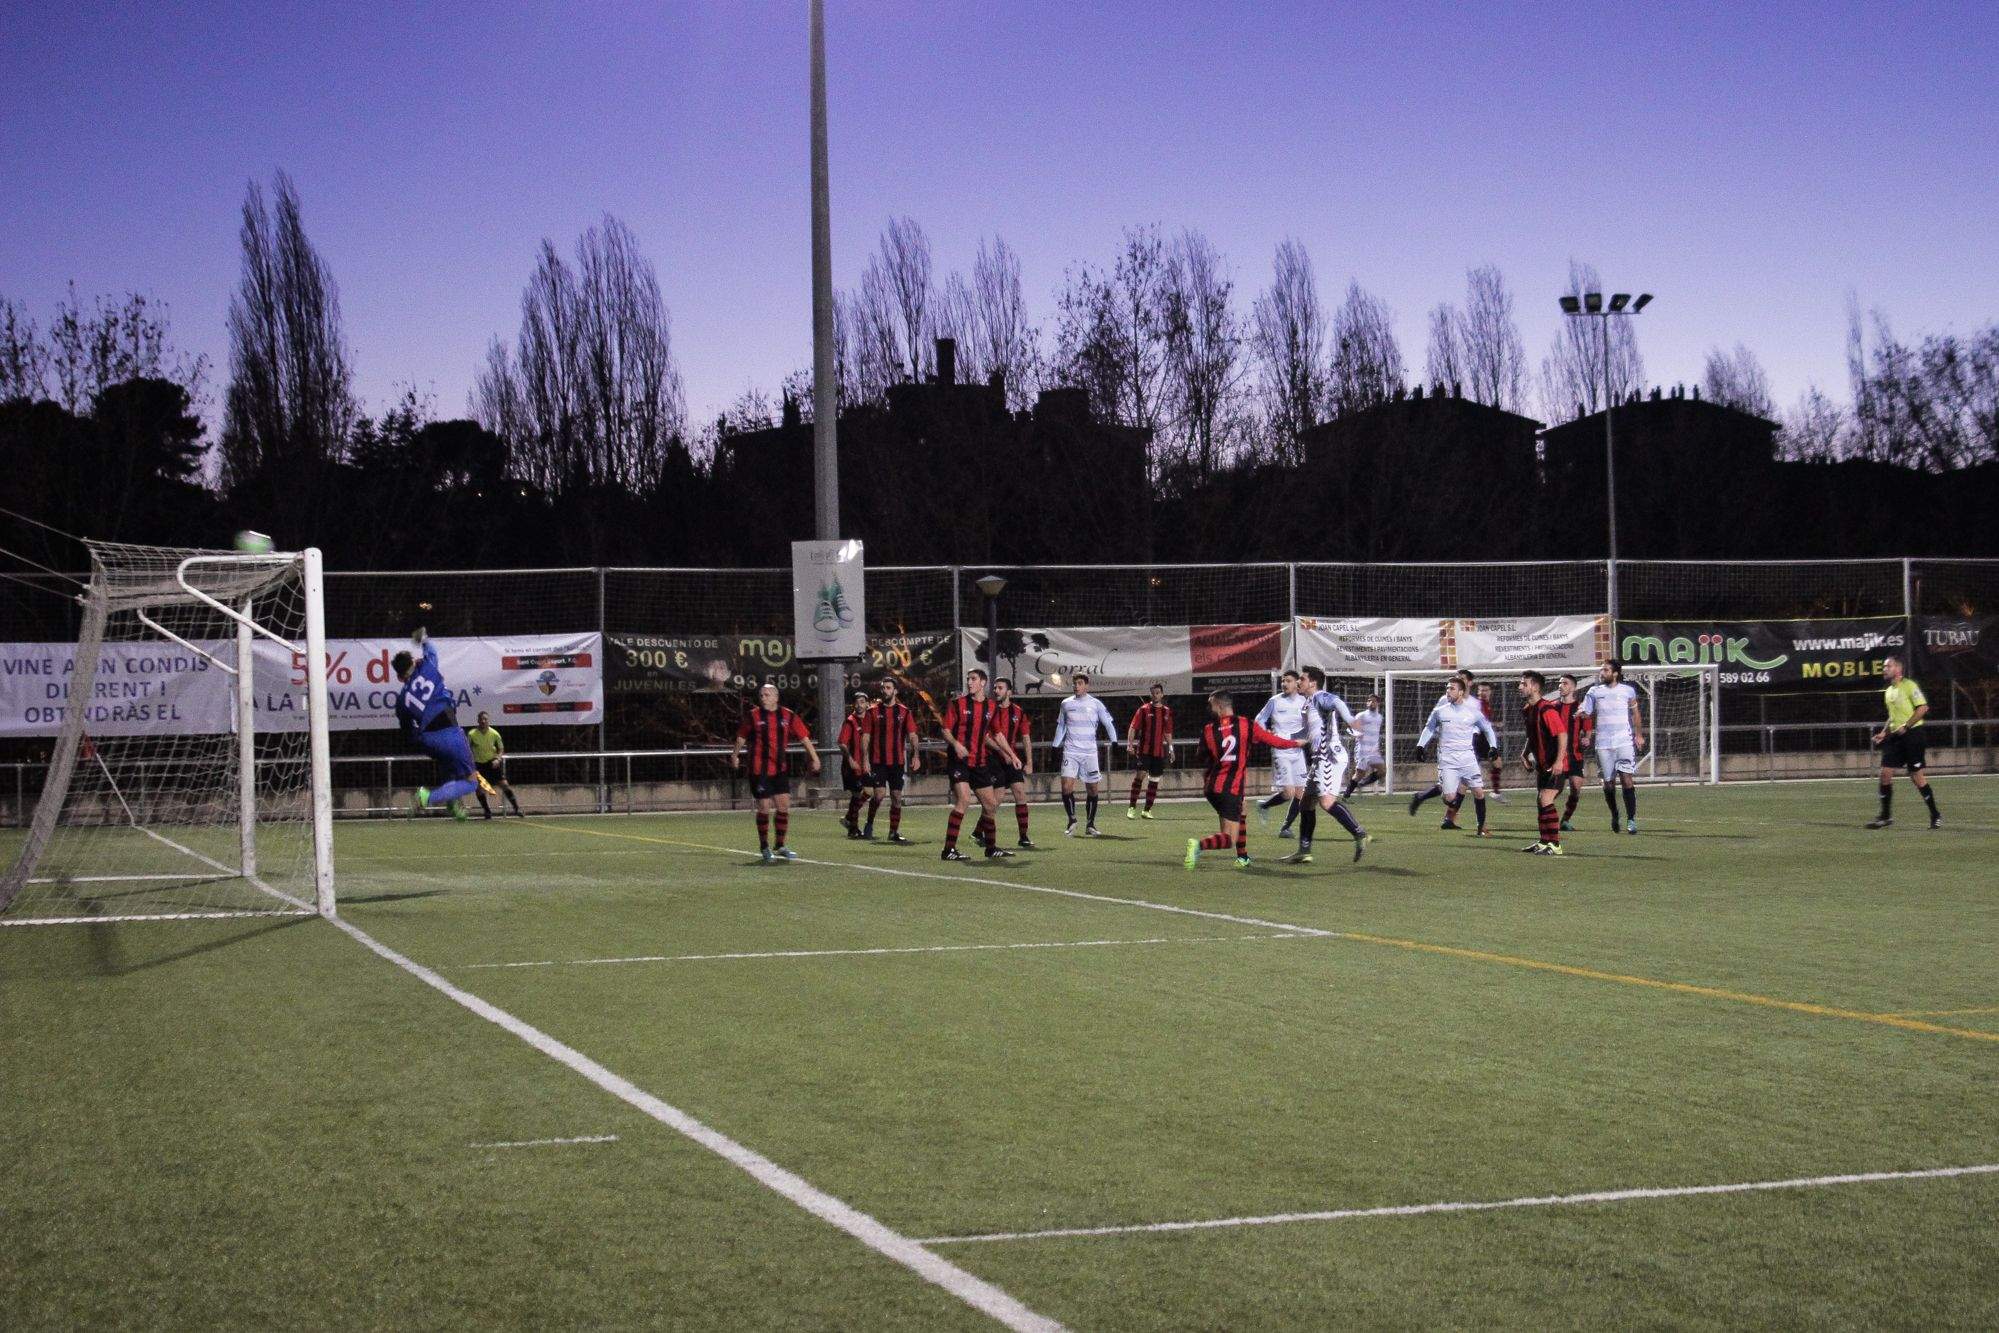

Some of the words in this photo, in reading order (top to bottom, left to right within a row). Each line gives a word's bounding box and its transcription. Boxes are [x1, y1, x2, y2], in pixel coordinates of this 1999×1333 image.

[637, 638, 702, 648] DESCUENTO
[704, 639, 718, 648] DE
[1793, 632, 1904, 652] www.majik.es
[1924, 630, 1980, 646] TUBAU
[3, 659, 53, 676] VINE
[126, 657, 209, 674] CONDIS
[625, 649, 667, 668] 300
[674, 649, 689, 668] €
[872, 650, 912, 668] 200
[919, 649, 932, 666] €
[1035, 648, 1118, 675] Corral
[1720, 673, 1738, 683] 589
[1741, 673, 1754, 683] 02
[1756, 672, 1770, 683] 66
[1802, 660, 1885, 678] MOBLE
[46, 681, 151, 699] DIRENT
[405, 675, 435, 712] 13
[614, 680, 697, 691] JUVENILES
[266, 693, 295, 711] LA
[158, 704, 181, 720] EL
[1220, 734, 1237, 762] 2
